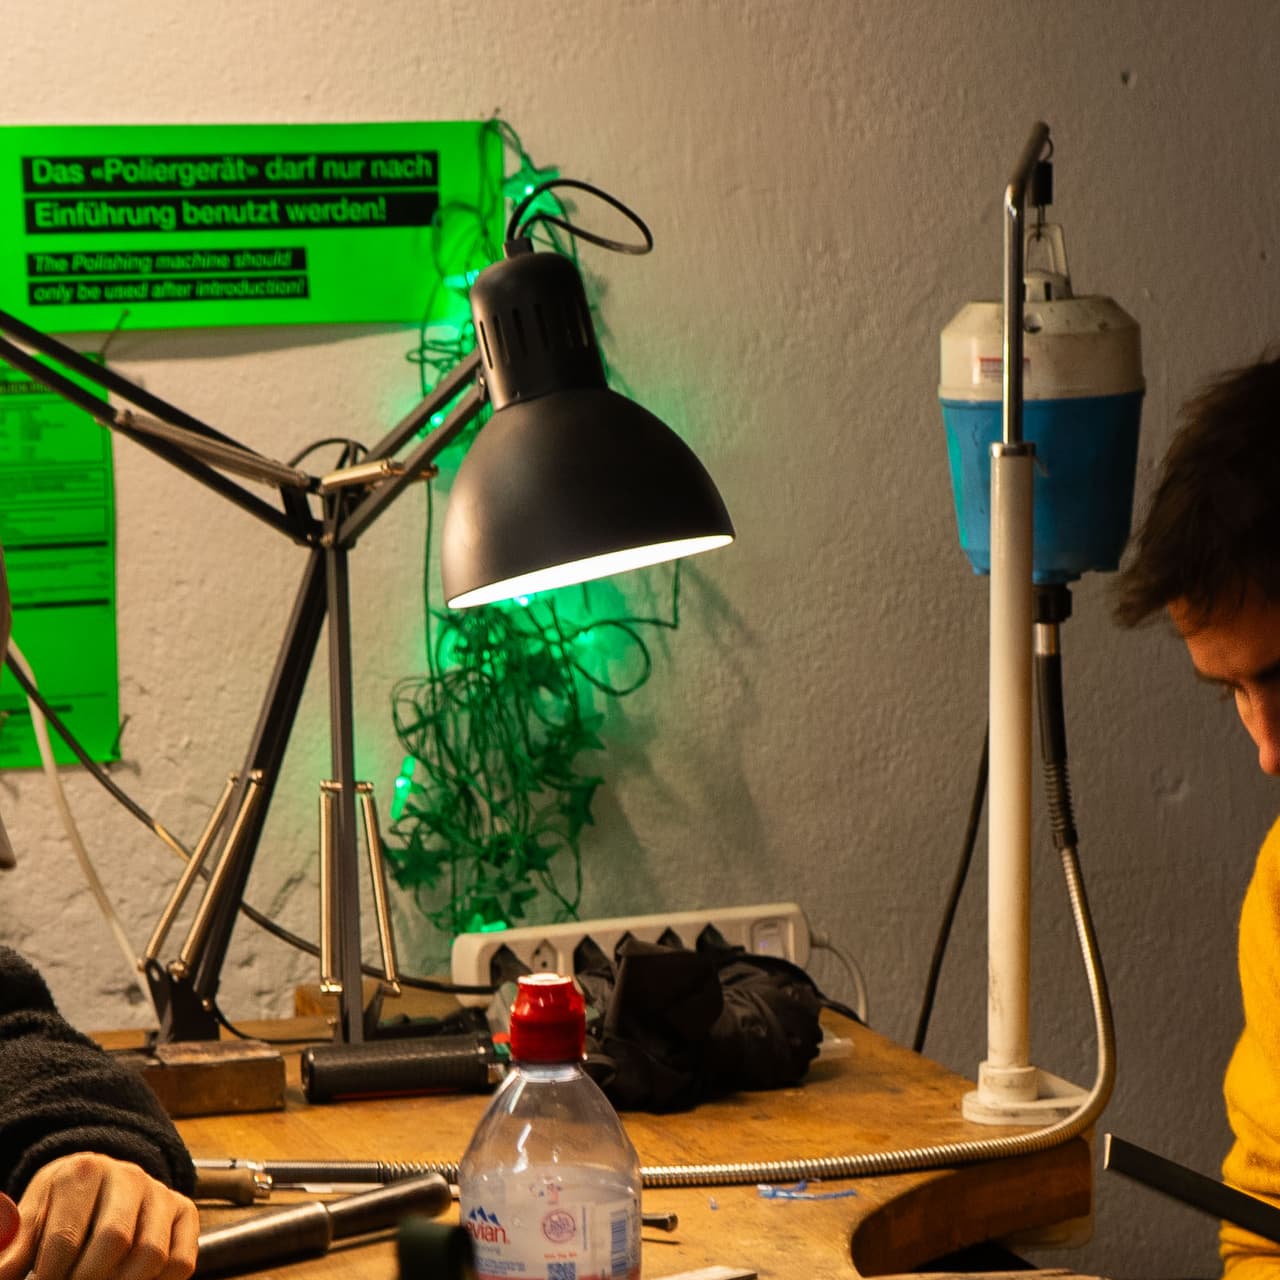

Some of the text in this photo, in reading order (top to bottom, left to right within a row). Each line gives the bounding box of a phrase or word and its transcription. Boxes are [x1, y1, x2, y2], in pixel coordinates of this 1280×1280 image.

[31, 158, 85, 185] Das
[265, 155, 317, 179] darf
[322, 158, 366, 179] nur
[370, 153, 433, 179] nach
[34, 197, 386, 230] Einführung benutzt werden!
[33, 249, 293, 274] The Polishing machine should
[33, 284, 74, 304] only
[77, 282, 102, 300] be
[104, 281, 149, 299] used
[151, 280, 193, 298] after
